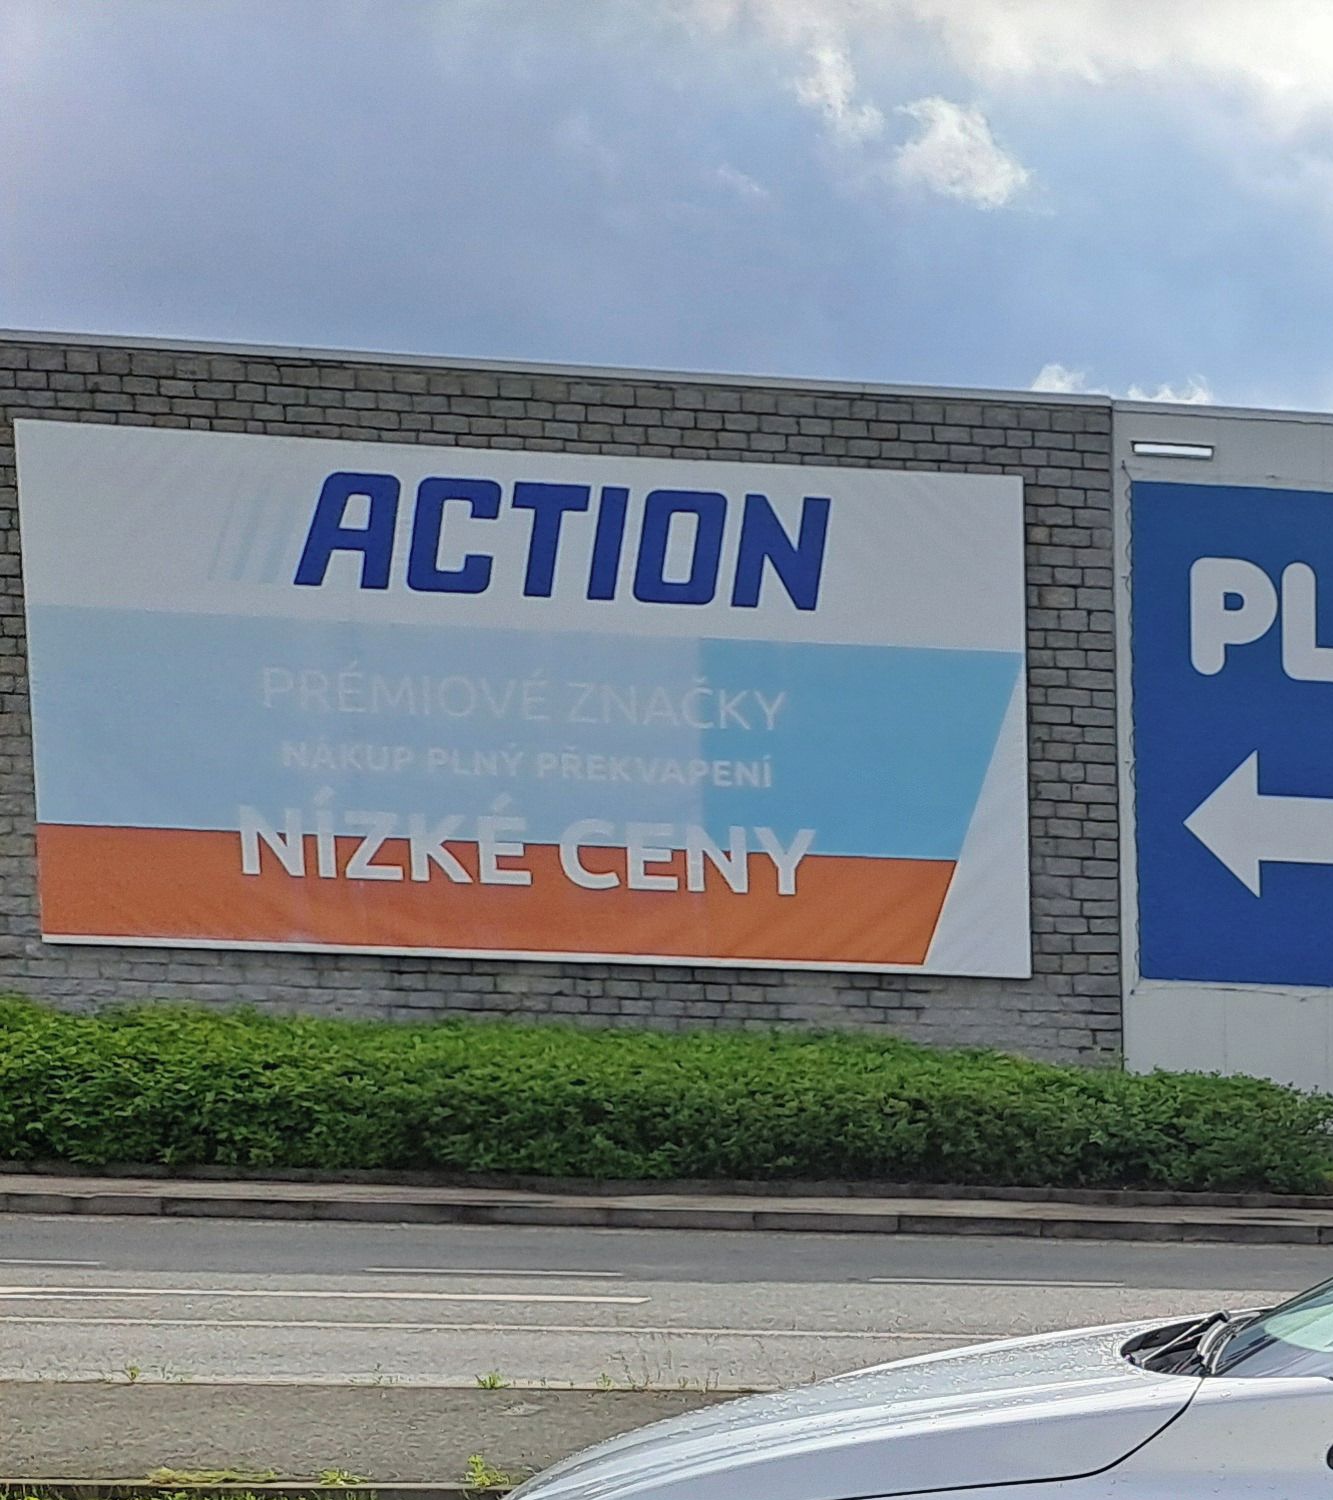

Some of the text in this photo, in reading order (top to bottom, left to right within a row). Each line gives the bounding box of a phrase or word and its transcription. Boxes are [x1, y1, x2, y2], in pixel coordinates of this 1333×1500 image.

[293, 471, 831, 611] ACTION
[261, 660, 788, 731] PRÉMIOVÉ ZNAČKY
[427, 741, 524, 778] PLNÝ
[535, 745, 773, 789] PŘEKVAPENÍ
[238, 785, 817, 896] NÍZKÉ CENY
